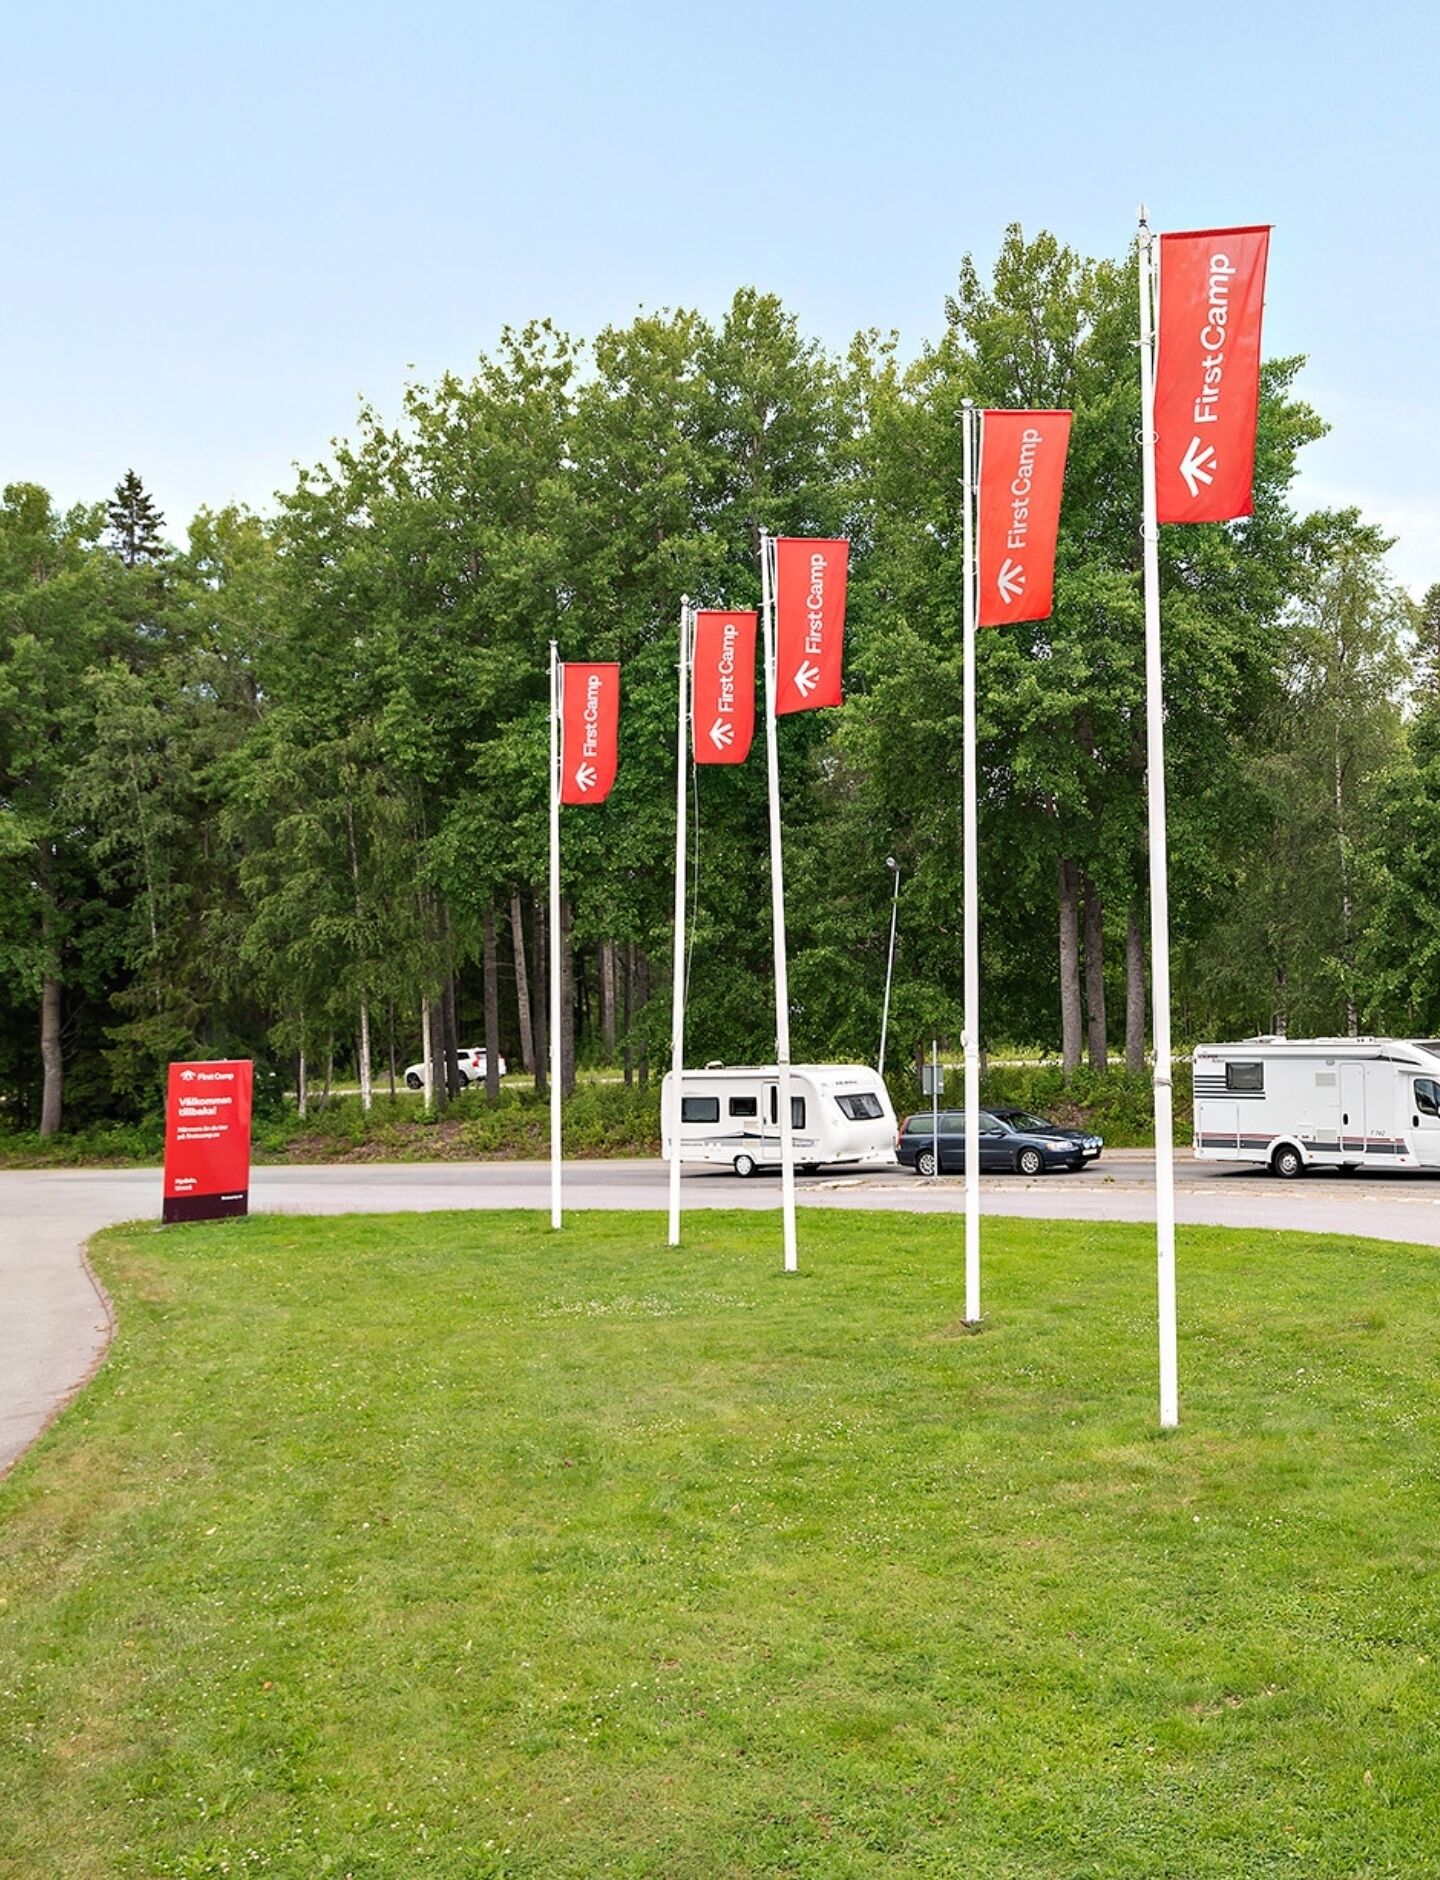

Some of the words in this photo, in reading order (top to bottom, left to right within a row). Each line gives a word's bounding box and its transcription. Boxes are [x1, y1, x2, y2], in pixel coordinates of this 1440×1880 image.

[1200, 252, 1236, 351] Camp
[1193, 351, 1223, 424] First
[1011, 428, 1043, 496] Camp
[1007, 499, 1030, 550] First
[806, 552, 828, 610] Camp
[717, 623, 739, 675] Camp
[804, 611, 824, 655] First
[583, 675, 603, 721] Camp
[717, 675, 735, 713] First
[582, 721, 598, 758] First
[197, 1072, 215, 1080] First
[215, 1072, 235, 1081] Camp
[178, 1096, 232, 1107] Välkommen
